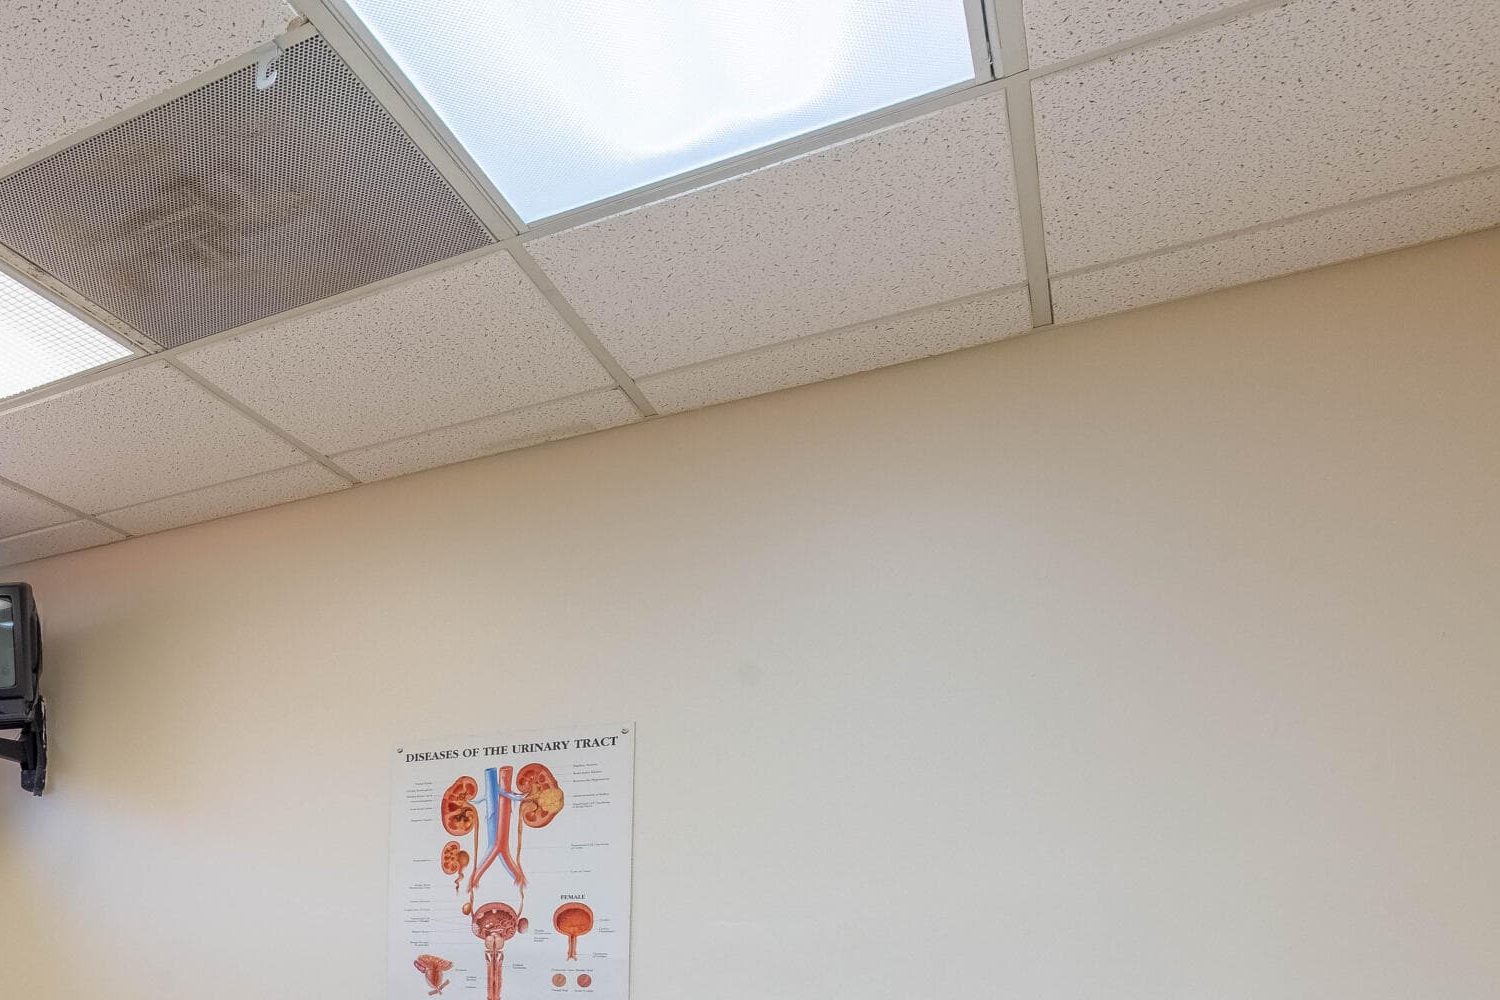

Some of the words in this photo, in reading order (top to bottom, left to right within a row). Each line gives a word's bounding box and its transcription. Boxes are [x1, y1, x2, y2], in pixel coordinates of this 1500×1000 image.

[406, 749, 459, 763] DISEASES
[462, 747, 479, 758] OF
[483, 745, 508, 756] THE
[512, 740, 570, 754] URINARY
[574, 735, 619, 749] TRACT
